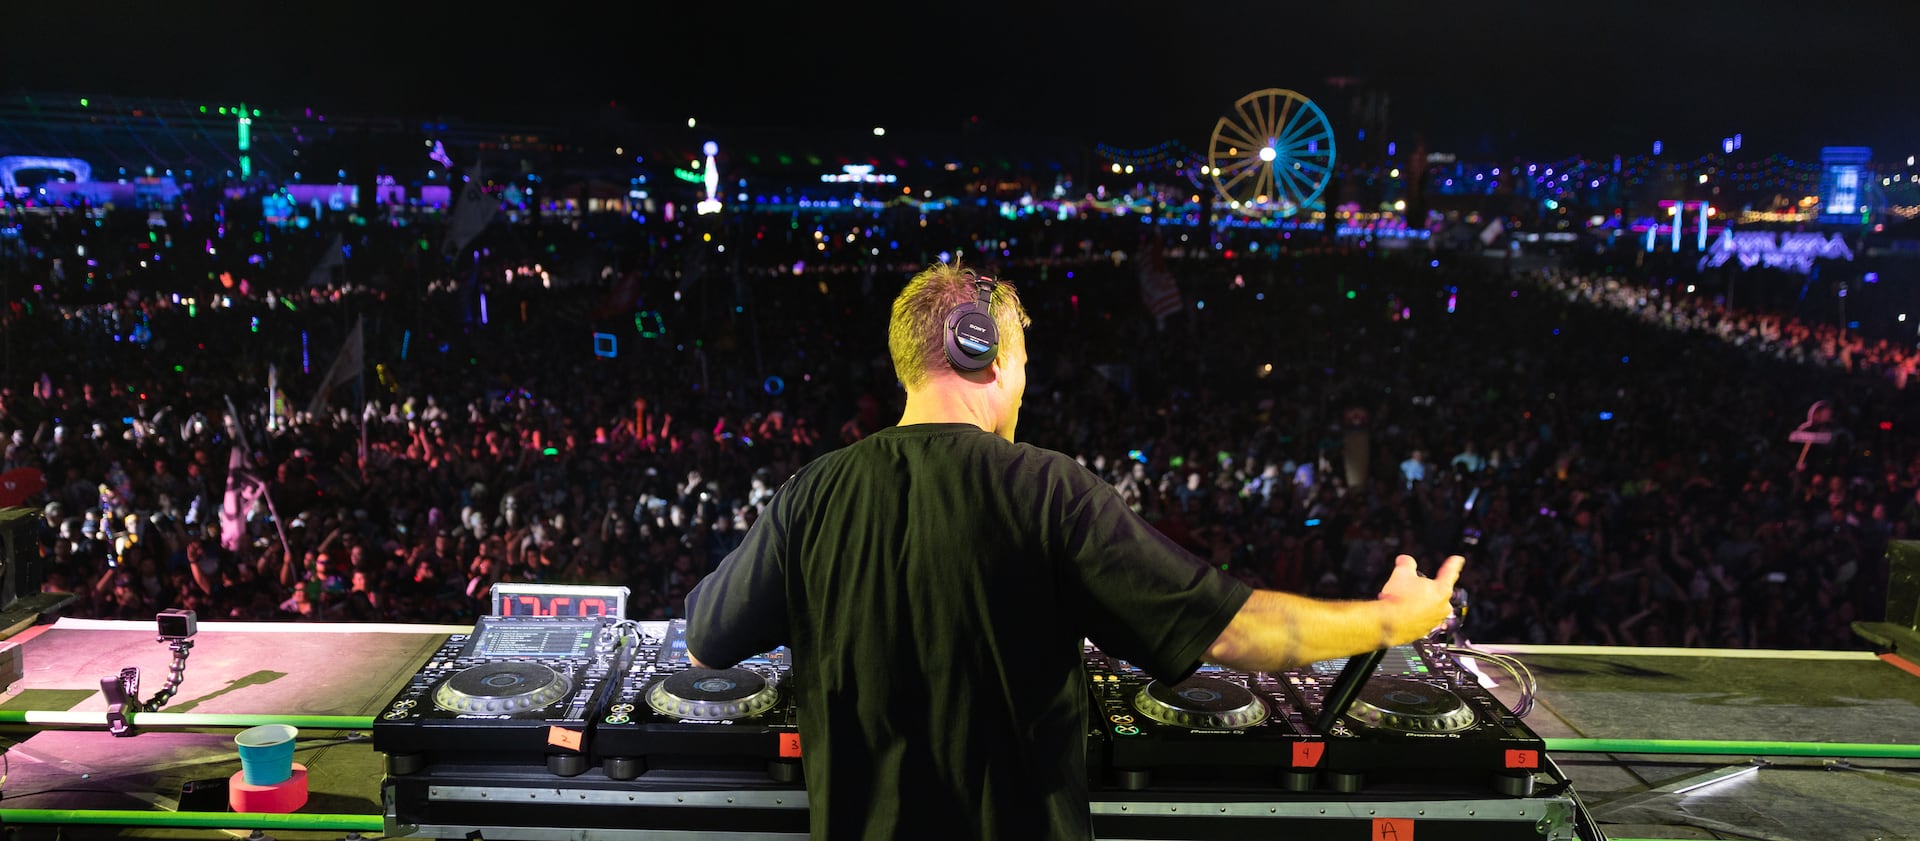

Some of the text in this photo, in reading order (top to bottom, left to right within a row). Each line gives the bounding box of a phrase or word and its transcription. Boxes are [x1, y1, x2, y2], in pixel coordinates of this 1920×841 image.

[969, 323, 987, 333] SONY
[561, 734, 571, 744] 2
[791, 739, 799, 750] 3
[1302, 747, 1310, 760] 4
[1517, 752, 1526, 764] 5
